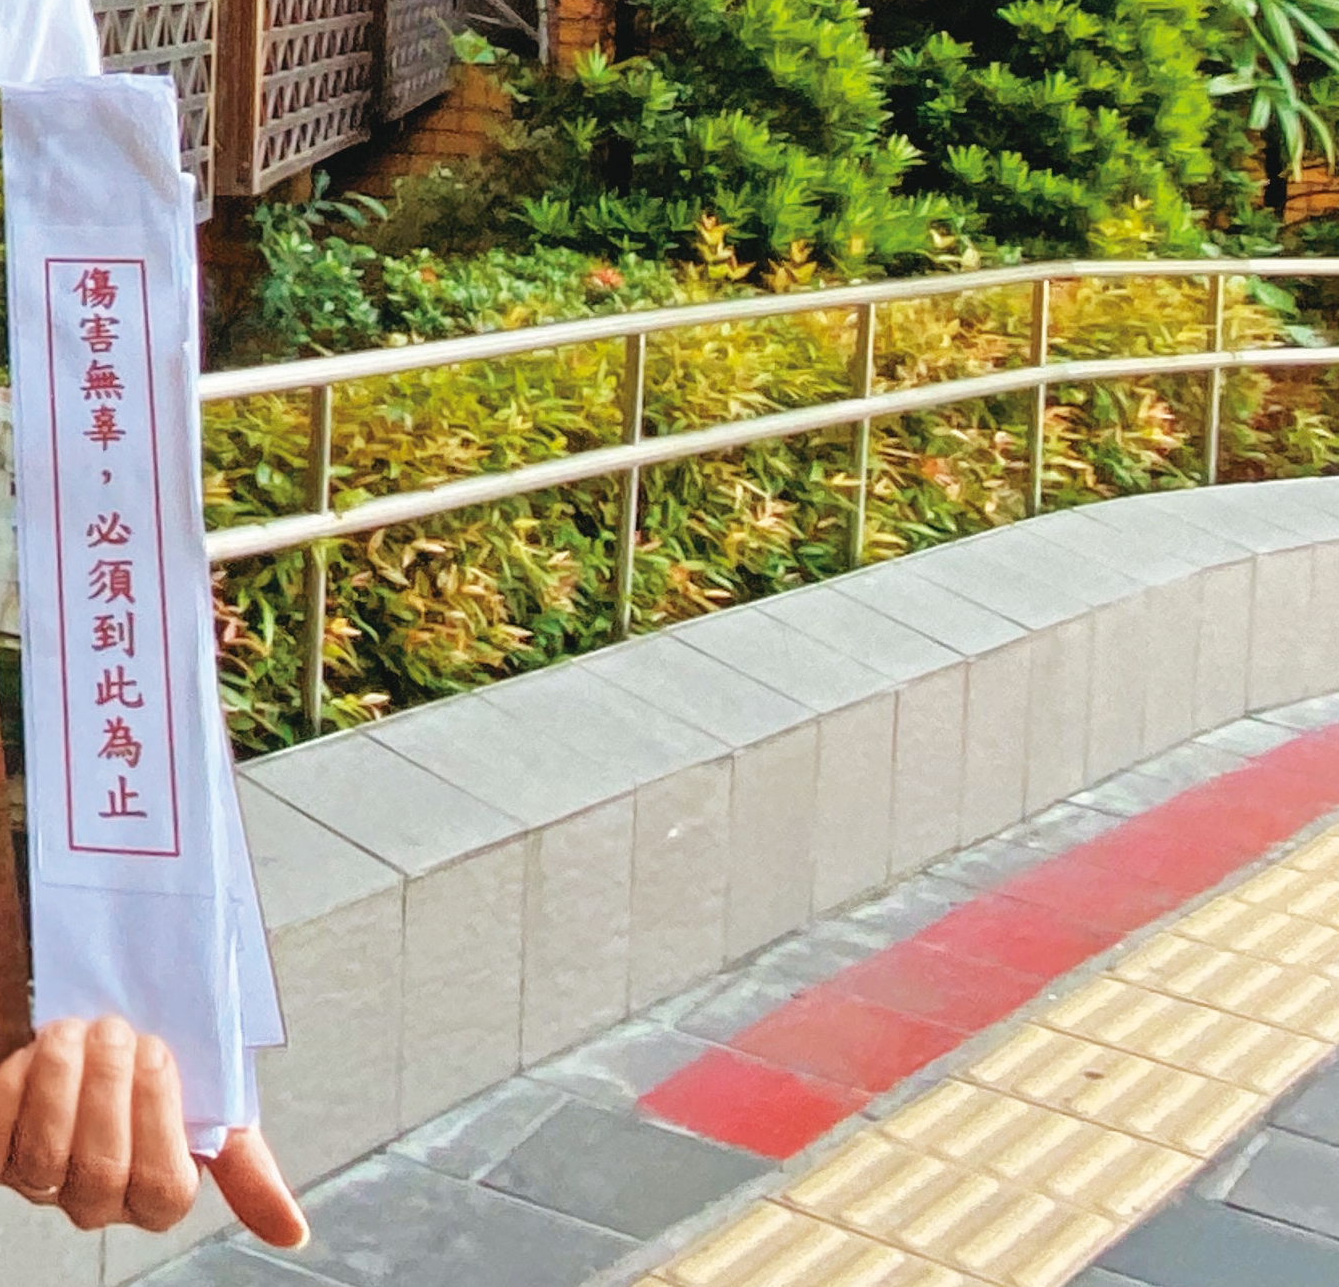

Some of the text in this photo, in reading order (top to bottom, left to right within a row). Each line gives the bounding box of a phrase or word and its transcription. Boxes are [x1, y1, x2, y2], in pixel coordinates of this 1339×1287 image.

[72, 267, 148, 820] 傷害無辜，必須到此為止
